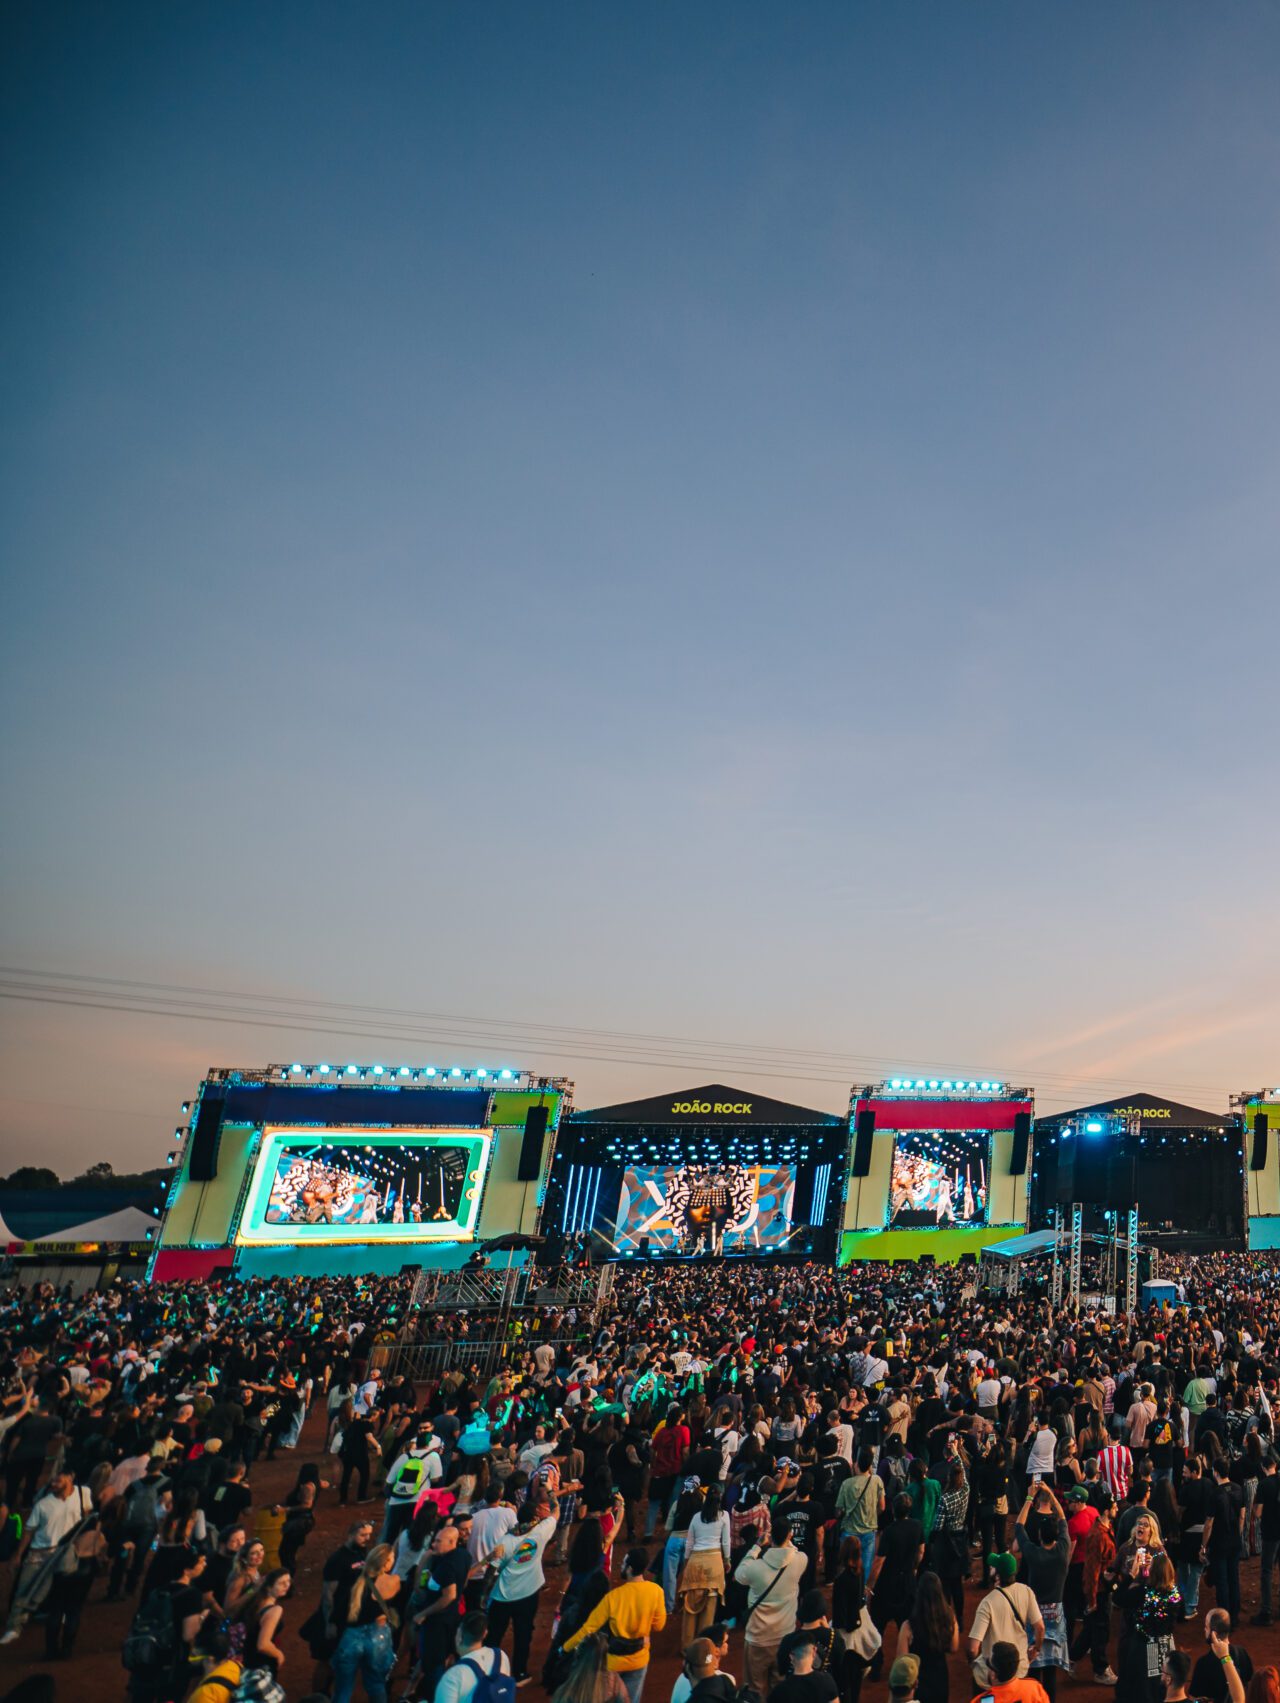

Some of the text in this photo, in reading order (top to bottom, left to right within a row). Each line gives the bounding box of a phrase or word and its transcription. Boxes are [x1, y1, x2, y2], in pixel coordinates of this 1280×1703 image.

[671, 1100, 752, 1114] JOÃO ROCK
[1143, 1108, 1171, 1118] ROCK
[33, 1242, 76, 1253] MULHER
